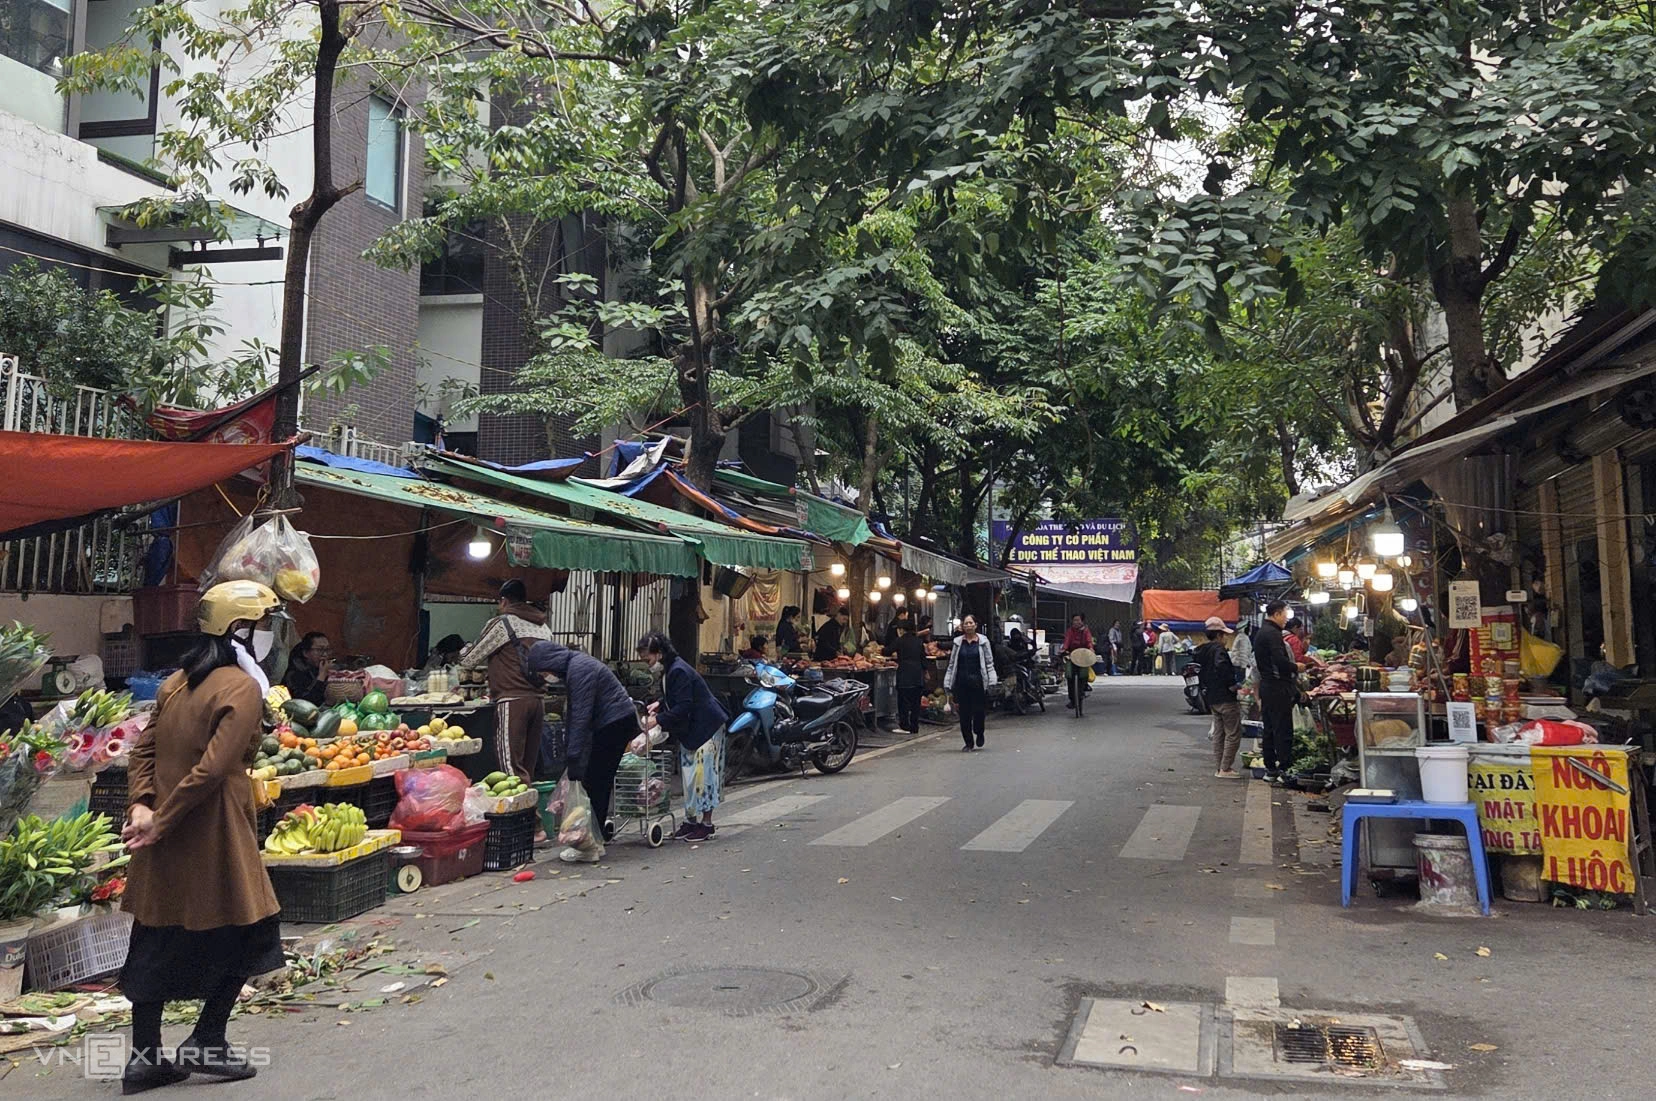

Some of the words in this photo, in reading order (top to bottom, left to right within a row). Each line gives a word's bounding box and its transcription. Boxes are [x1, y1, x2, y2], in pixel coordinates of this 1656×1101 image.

[1022, 533, 1050, 546] CÔNG
[1051, 535, 1064, 546] TY
[1065, 531, 1079, 545] CỔ
[1017, 550, 1038, 563] DỤC
[1060, 549, 1086, 561] THAO
[1088, 547, 1109, 562] VIỆT
[1111, 549, 1135, 561] NAM
[1551, 751, 1611, 791] NGÔ
[1468, 773, 1495, 793] TẠI
[1484, 797, 1526, 823] MẬT
[1543, 804, 1626, 843] KHOAI
